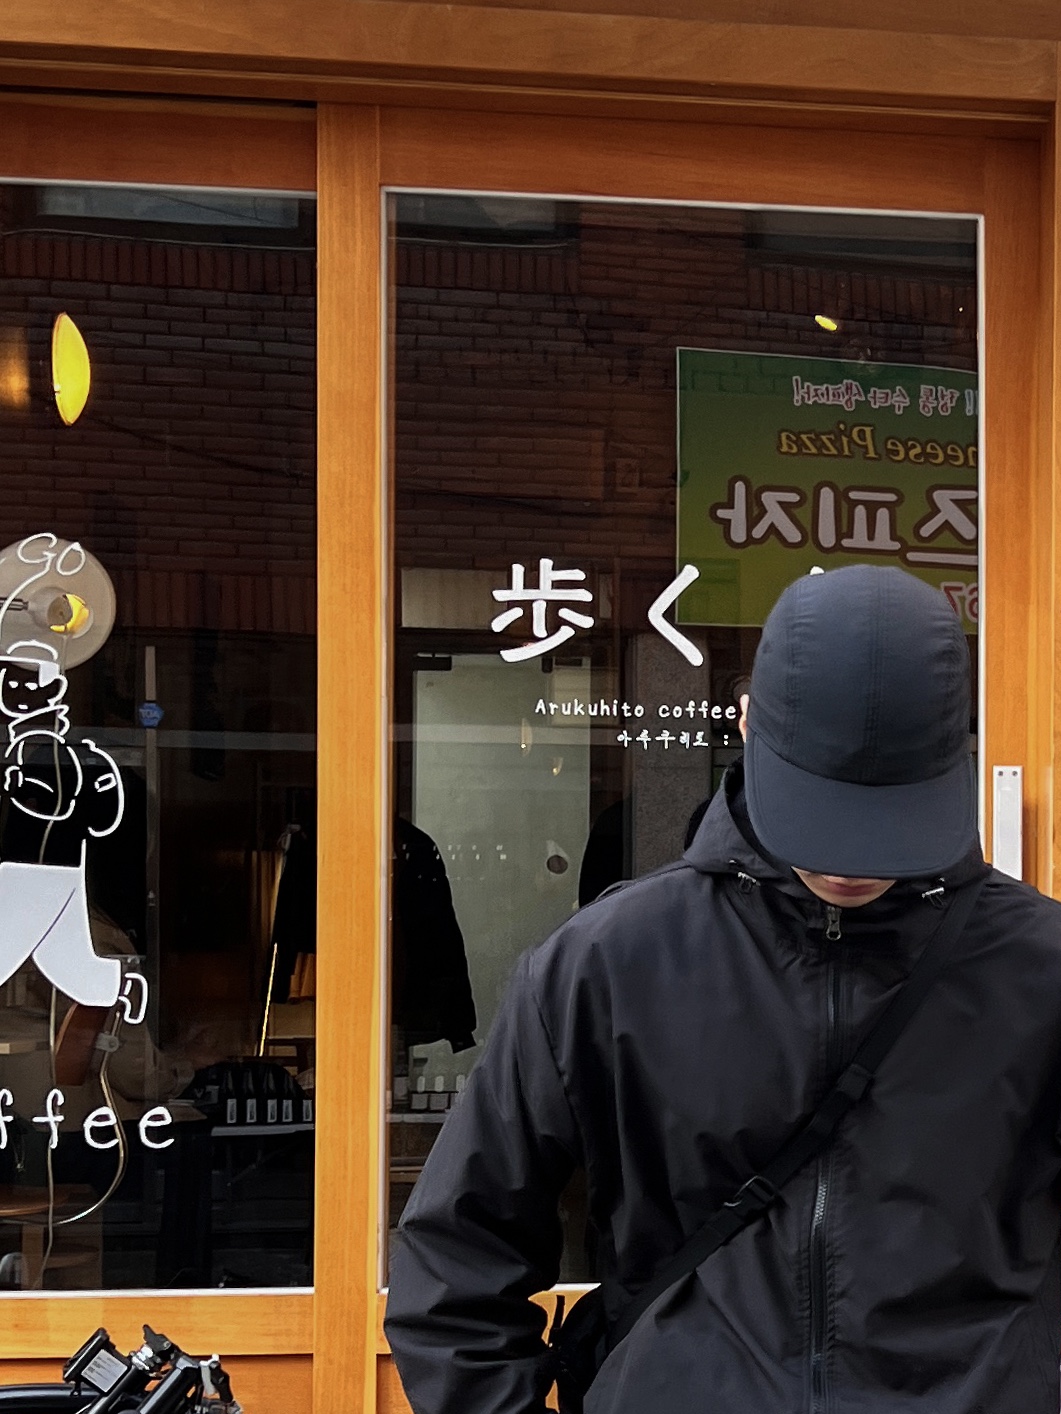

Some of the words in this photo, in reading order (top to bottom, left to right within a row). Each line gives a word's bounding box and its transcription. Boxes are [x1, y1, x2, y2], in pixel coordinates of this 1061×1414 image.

[535, 699, 645, 719] Arukuhito
[658, 700, 738, 720] coffee
[0, 1088, 175, 1149] ffee
